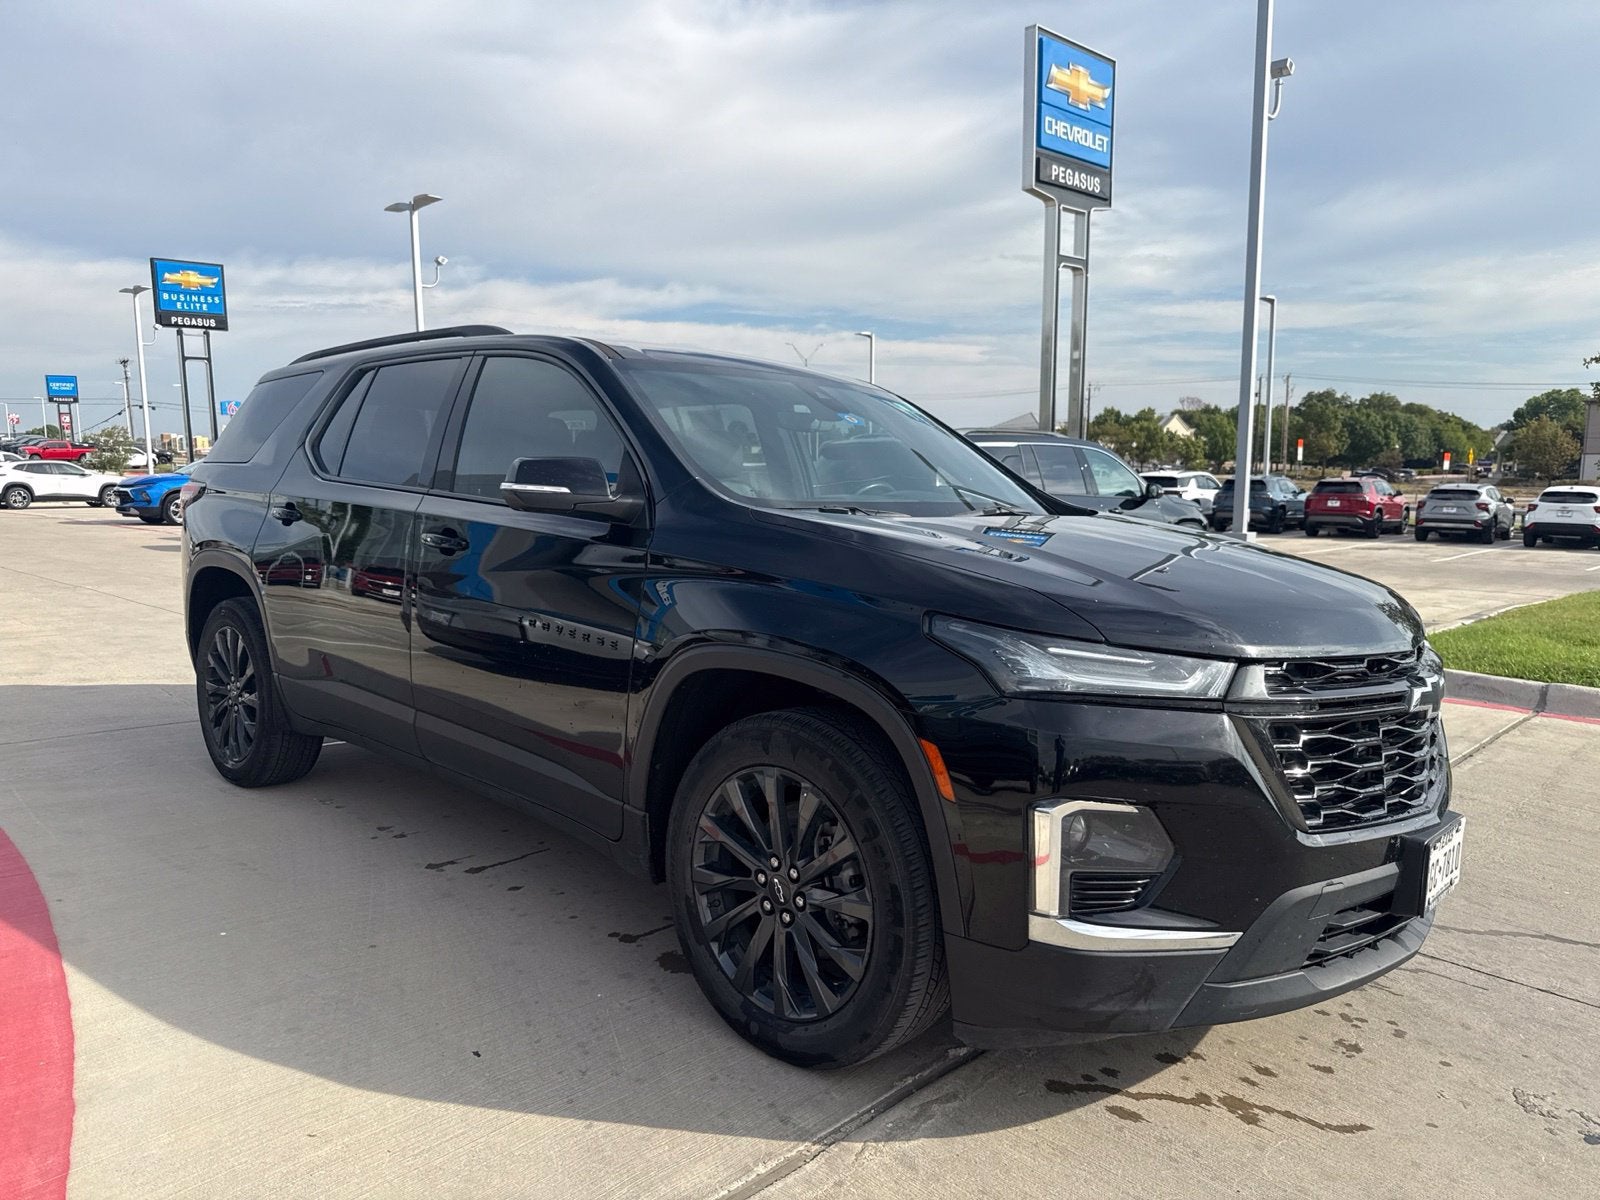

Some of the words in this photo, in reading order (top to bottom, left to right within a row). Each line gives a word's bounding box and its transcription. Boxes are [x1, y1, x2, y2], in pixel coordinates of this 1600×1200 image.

[1044, 116, 1109, 153] CHEVROLET
[1051, 164, 1101, 194] PEGASUS
[163, 292, 220, 304] BUSINESS
[176, 301, 208, 311] ELITE
[171, 316, 216, 328] PEGASUS
